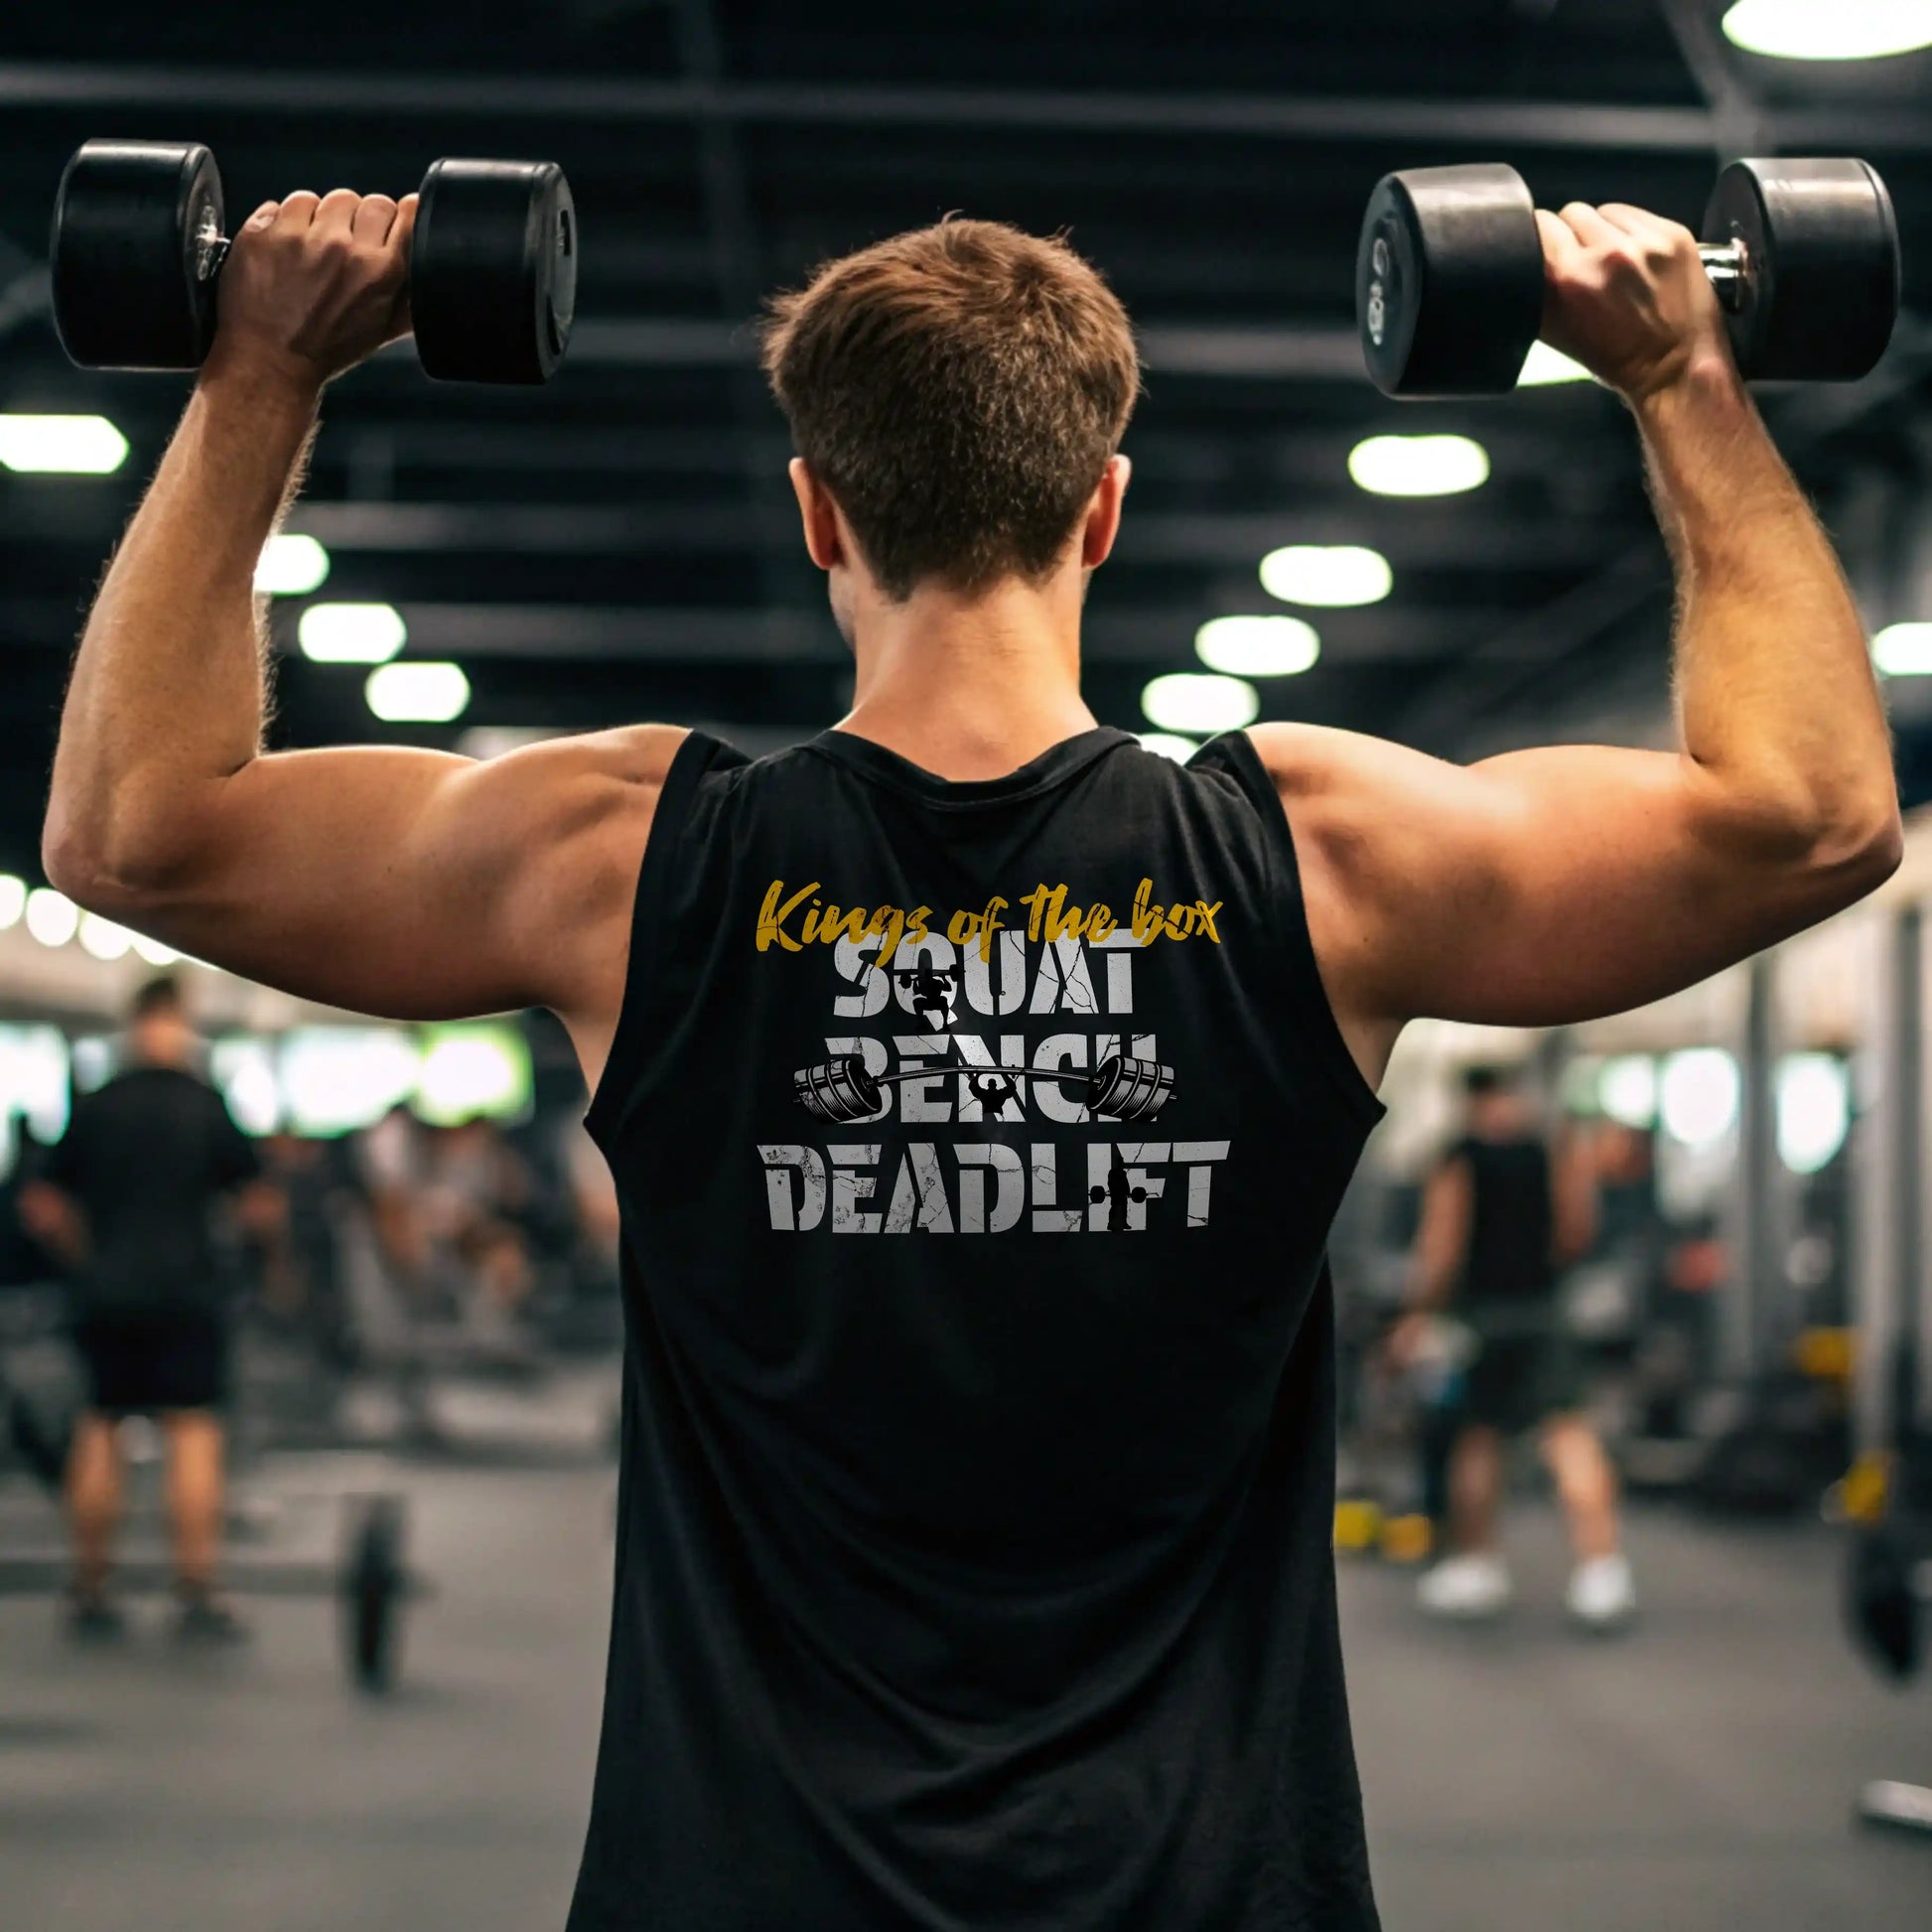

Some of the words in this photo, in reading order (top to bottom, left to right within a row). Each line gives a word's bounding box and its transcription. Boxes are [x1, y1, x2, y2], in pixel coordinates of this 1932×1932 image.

[756, 880, 932, 968] Kings
[947, 896, 1009, 964] of
[1020, 883, 1119, 944] the
[1132, 878, 1224, 947] box
[833, 928, 1150, 1032] SQUAT
[756, 1140, 1232, 1234] DEADLIFT
